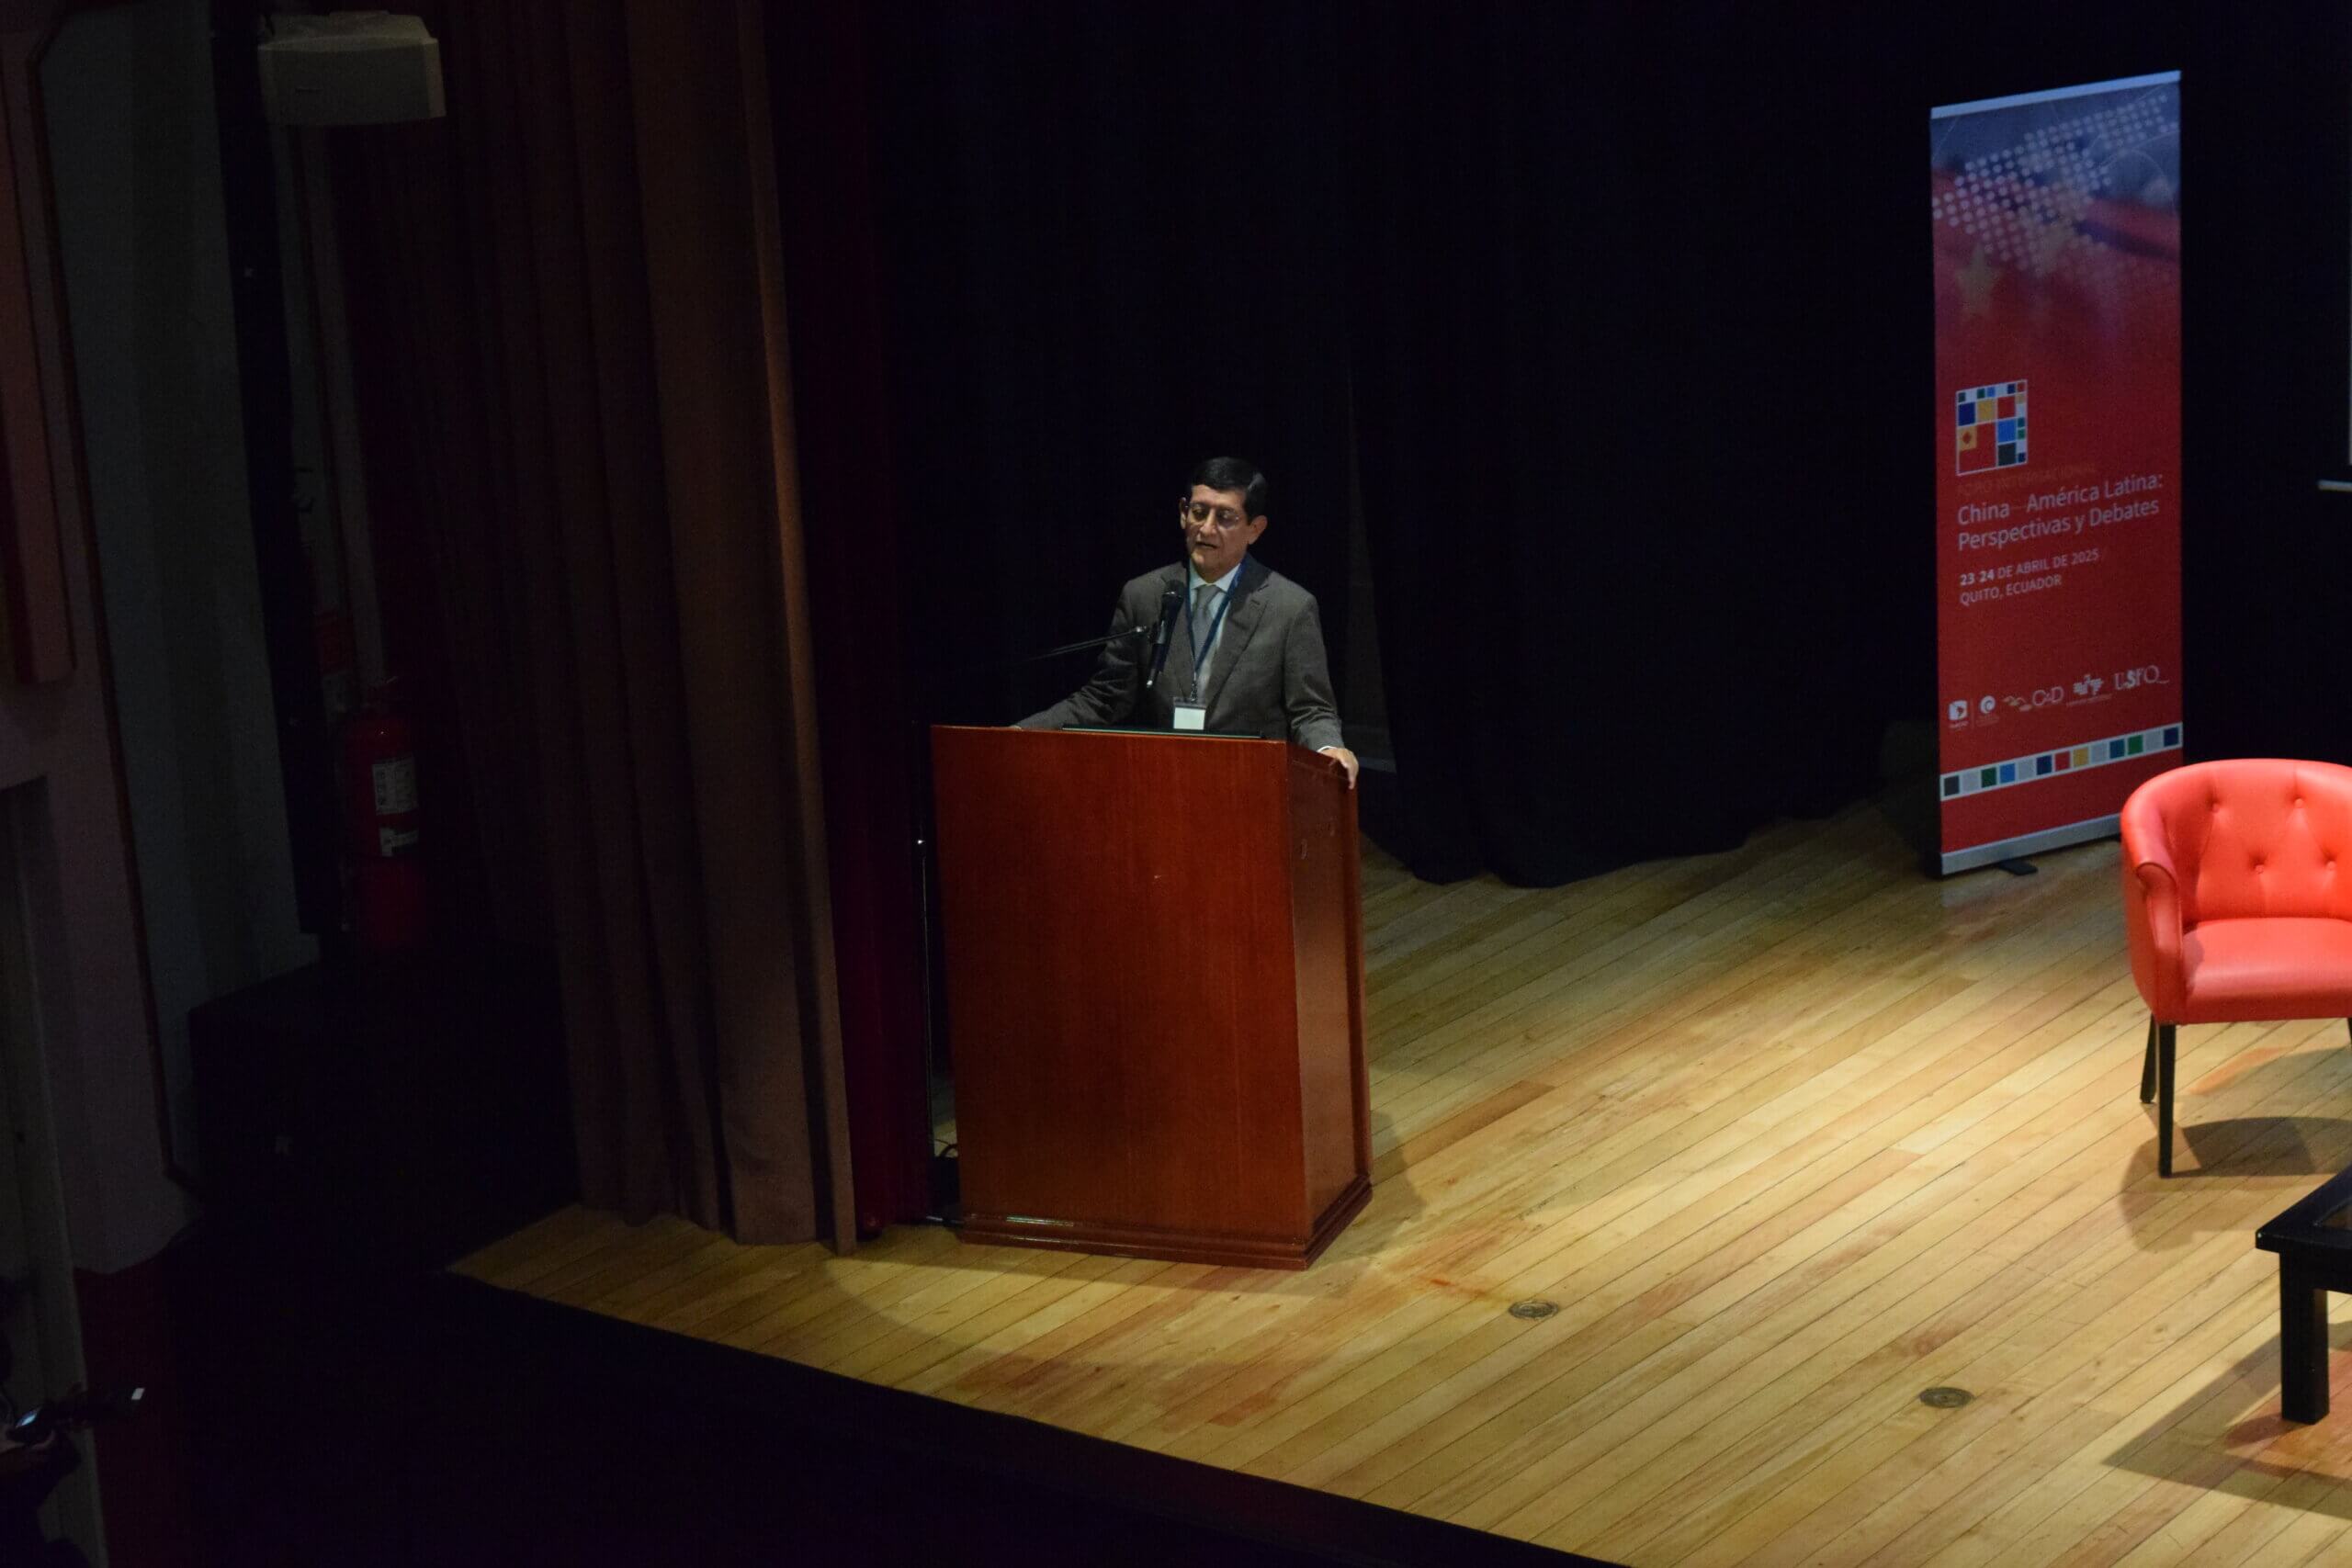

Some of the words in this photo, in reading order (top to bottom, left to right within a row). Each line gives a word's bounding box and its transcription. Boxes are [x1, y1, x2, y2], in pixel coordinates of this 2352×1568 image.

[1958, 501, 2009, 525] China
[2027, 485, 2099, 513] América
[2104, 472, 2164, 500] Latina:
[1958, 512, 2071, 551] Perspectivas
[2075, 515, 2086, 535] y
[2089, 499, 2159, 528] Debates
[1960, 571, 1975, 586] 23
[1978, 568, 1995, 583] 24
[1997, 564, 2013, 580] DE
[2015, 558, 2050, 576] ABRIL
[2052, 554, 2068, 569] DE
[2071, 547, 2099, 566] 2025
[1959, 586, 2005, 607] QUITO,
[2006, 574, 2063, 596] ECUADOR
